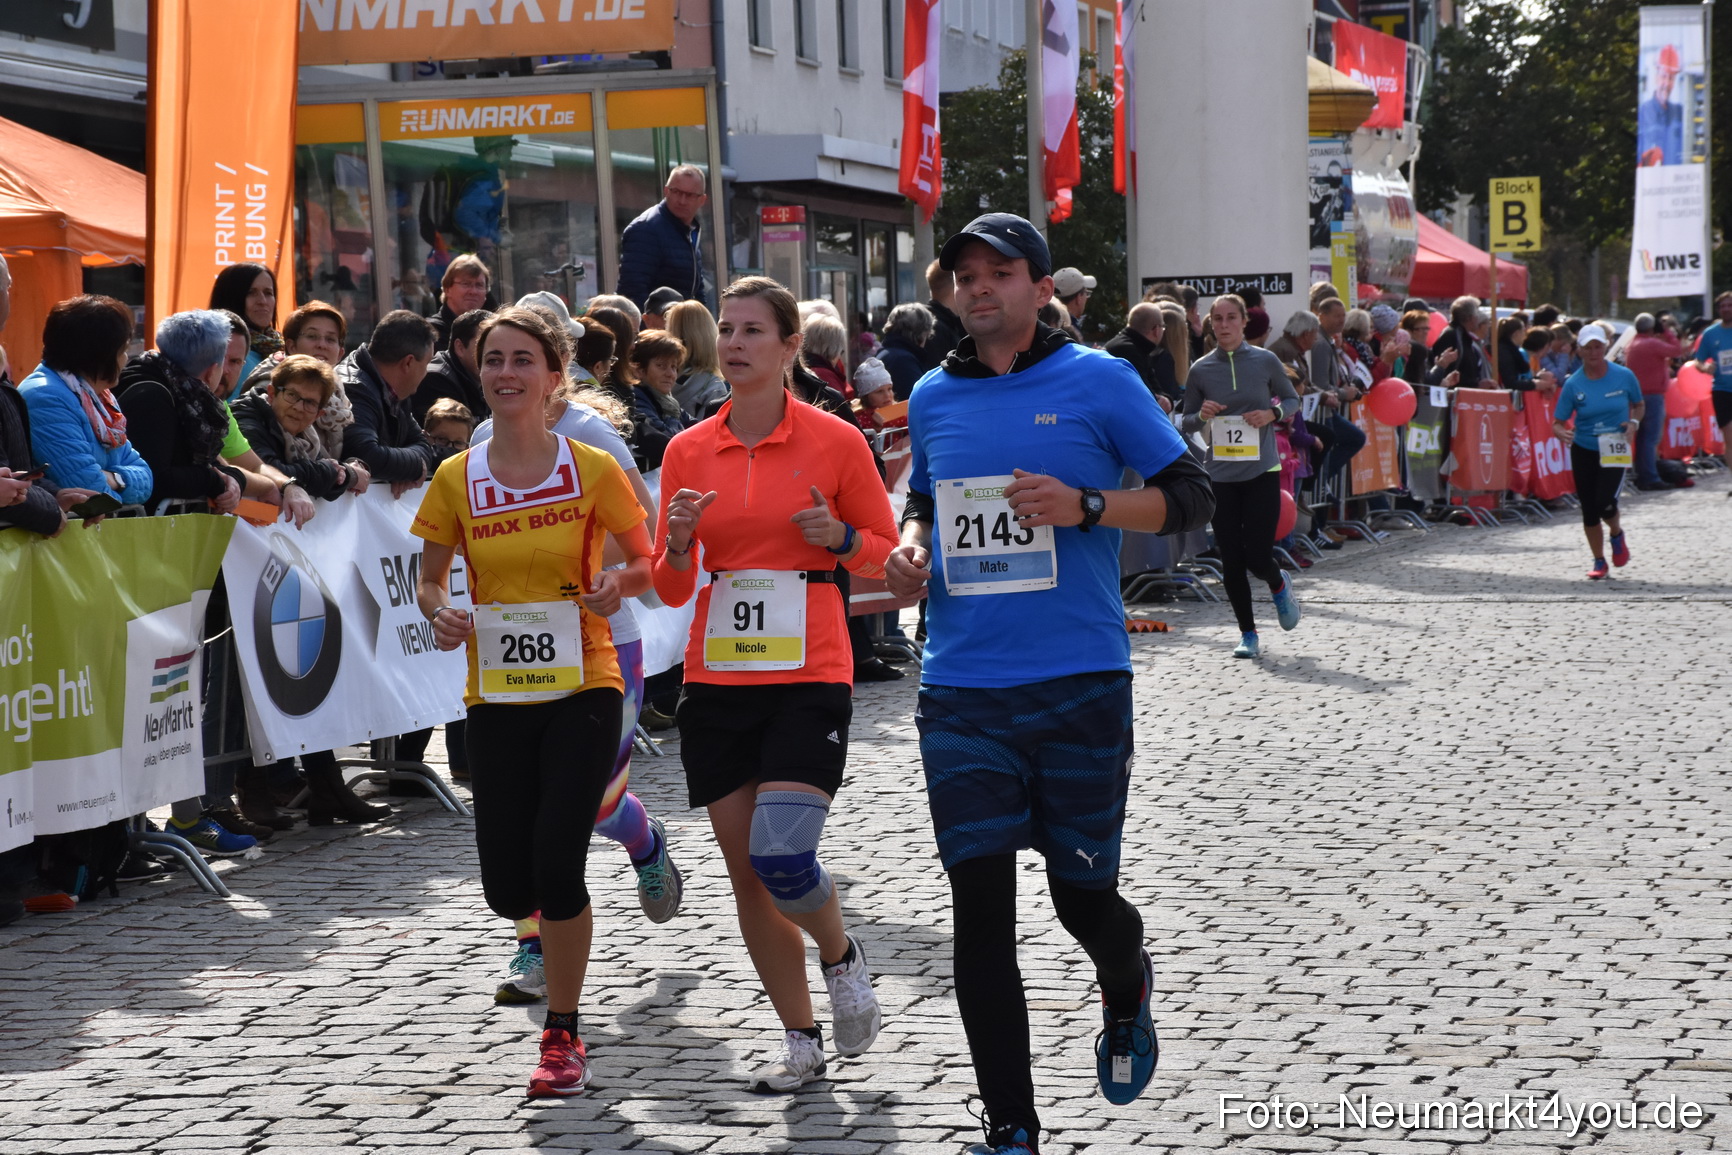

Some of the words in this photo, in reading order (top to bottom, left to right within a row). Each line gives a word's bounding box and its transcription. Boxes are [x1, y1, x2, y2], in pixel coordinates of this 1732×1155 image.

[401, 103, 575, 132] RUNMARKT.DE
[1495, 180, 1535, 195] Block
[244, 183, 267, 267] BUNG
[1503, 200, 1528, 236] B
[1226, 429, 1243, 444] 12
[974, 486, 1007, 499] BOC
[472, 518, 522, 540] MAX
[528, 507, 586, 530] BÖGL
[955, 512, 1034, 548] 2143
[979, 560, 1009, 573] Mate
[740, 579, 775, 588] BOCK
[513, 612, 548, 621] BOCK
[734, 600, 764, 631] 91
[500, 632, 556, 663] 268
[735, 642, 767, 654] Nicole
[506, 674, 524, 685] Eva
[526, 673, 556, 685] Maria
